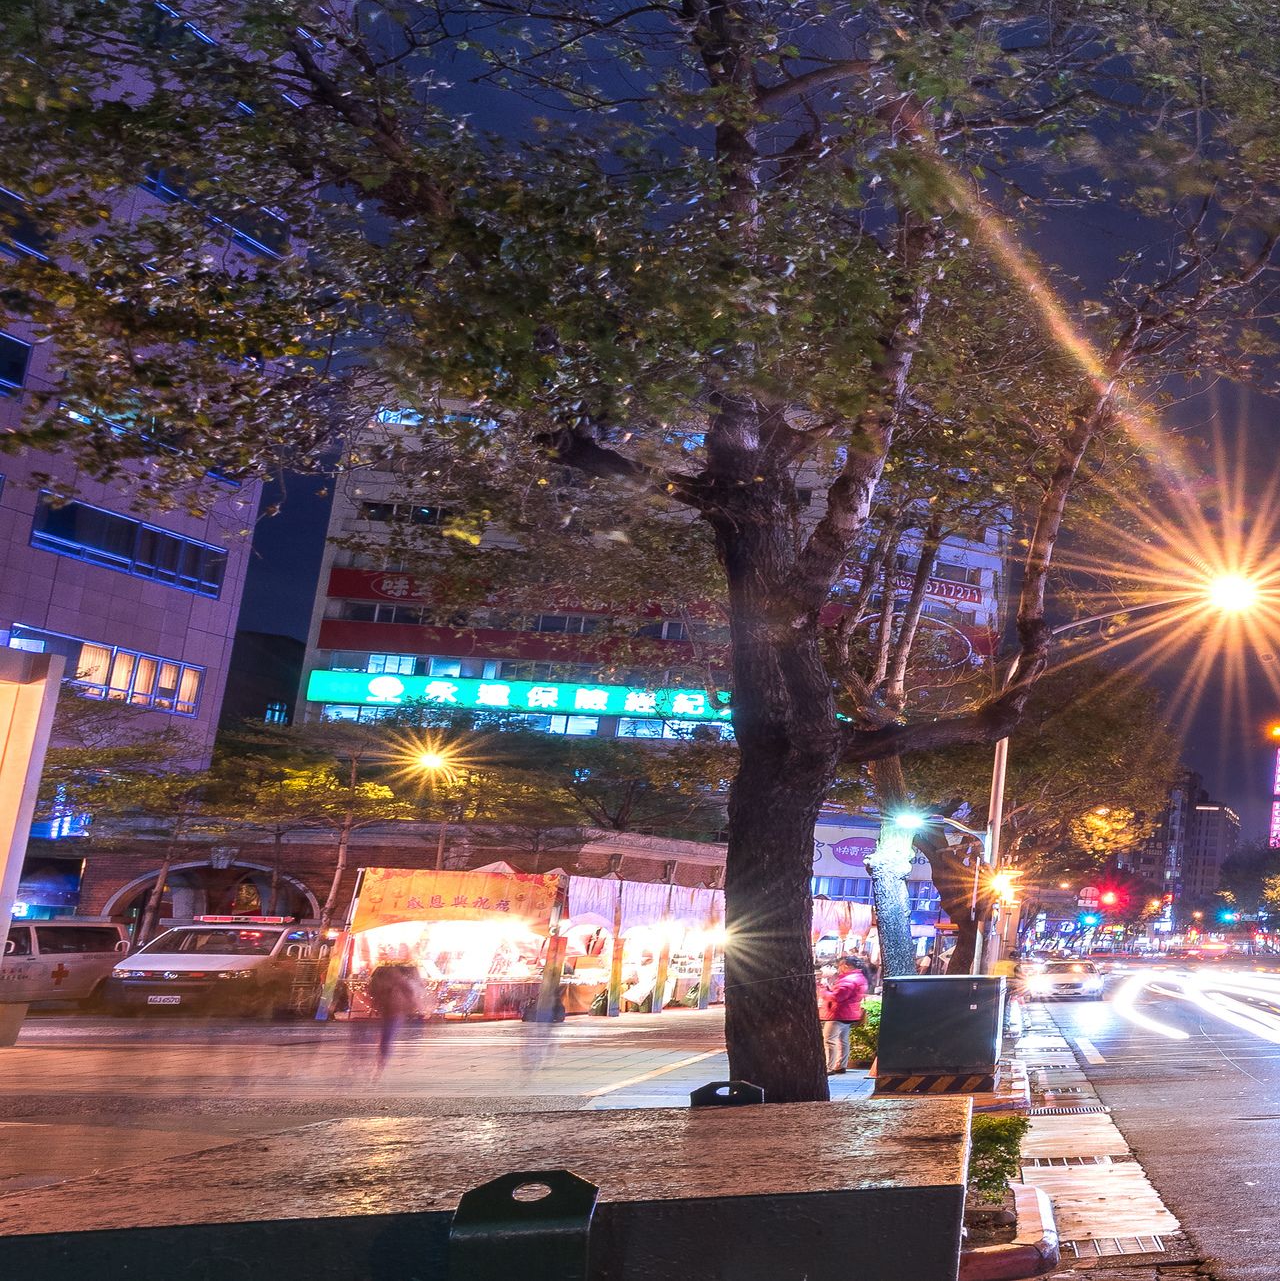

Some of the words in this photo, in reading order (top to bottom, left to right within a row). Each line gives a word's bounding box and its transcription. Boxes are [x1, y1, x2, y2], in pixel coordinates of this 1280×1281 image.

[406, 894, 511, 912] 感恩與祝福
